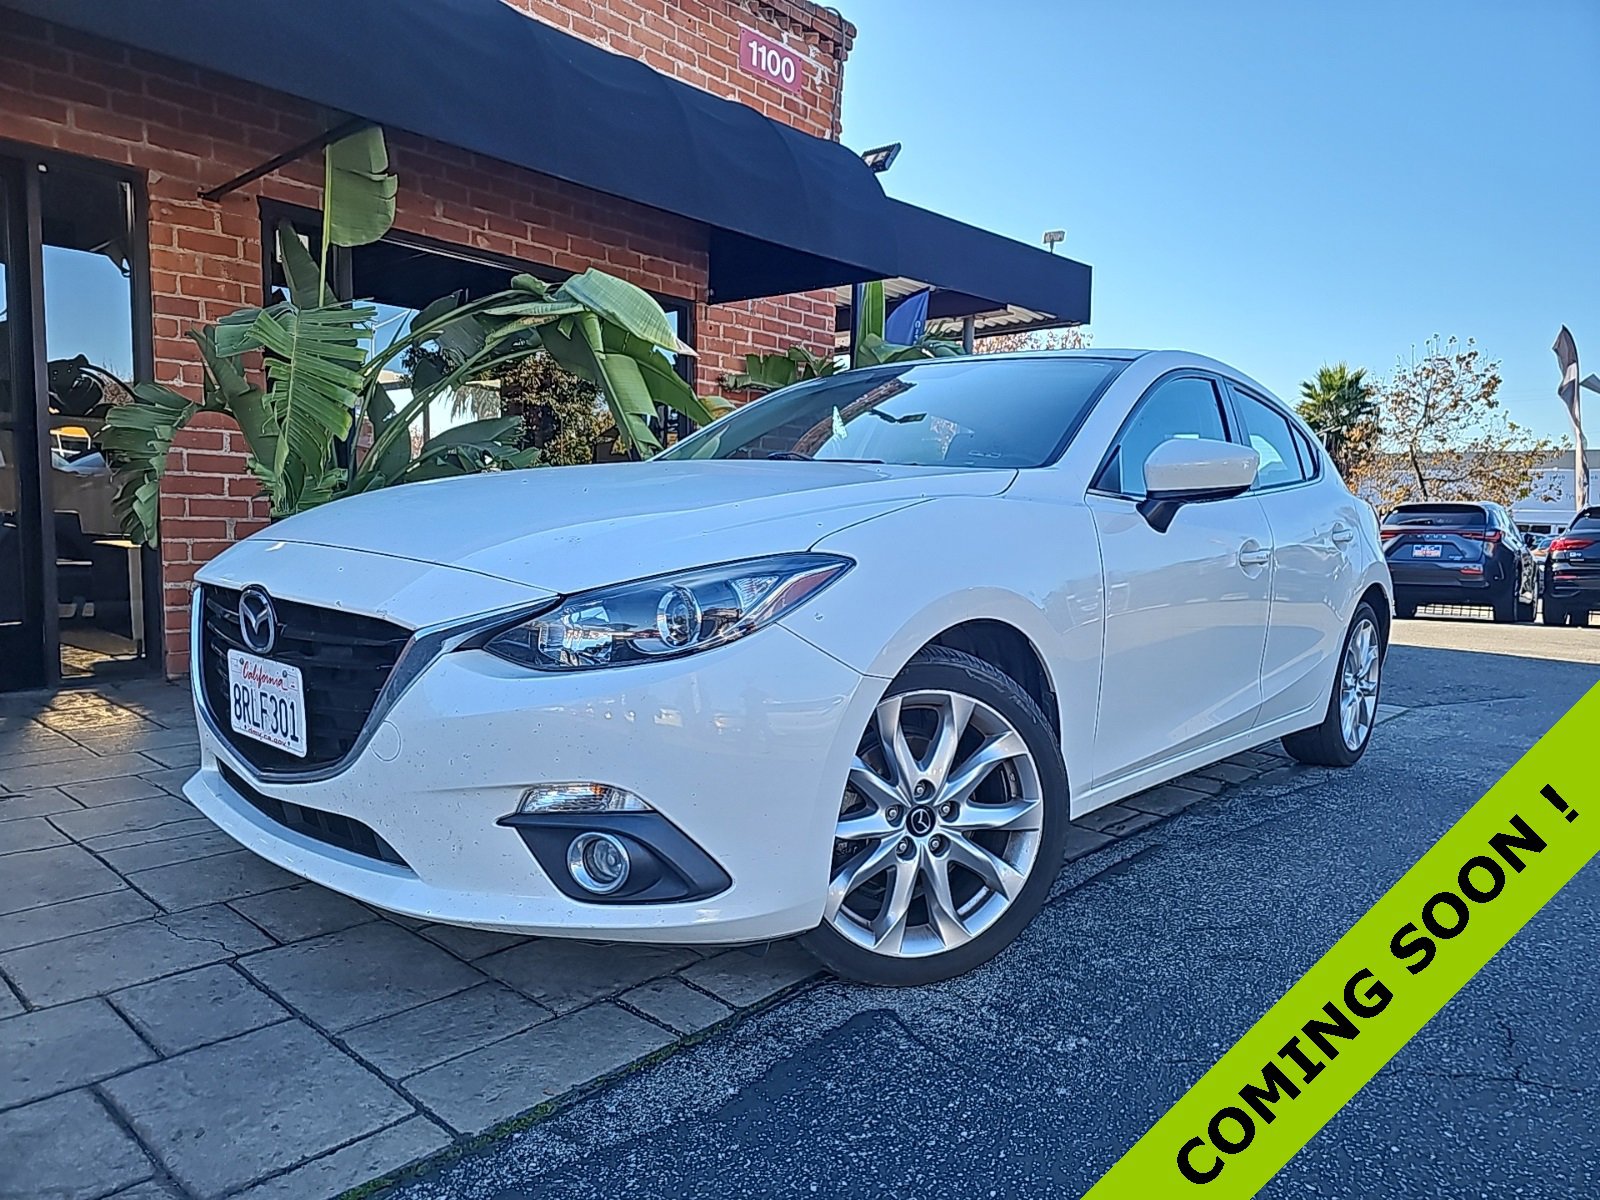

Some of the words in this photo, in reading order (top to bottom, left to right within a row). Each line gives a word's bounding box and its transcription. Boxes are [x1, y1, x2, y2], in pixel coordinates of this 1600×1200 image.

[748, 41, 796, 84] 1100
[243, 661, 289, 691] California
[233, 682, 300, 743] 8RLF301
